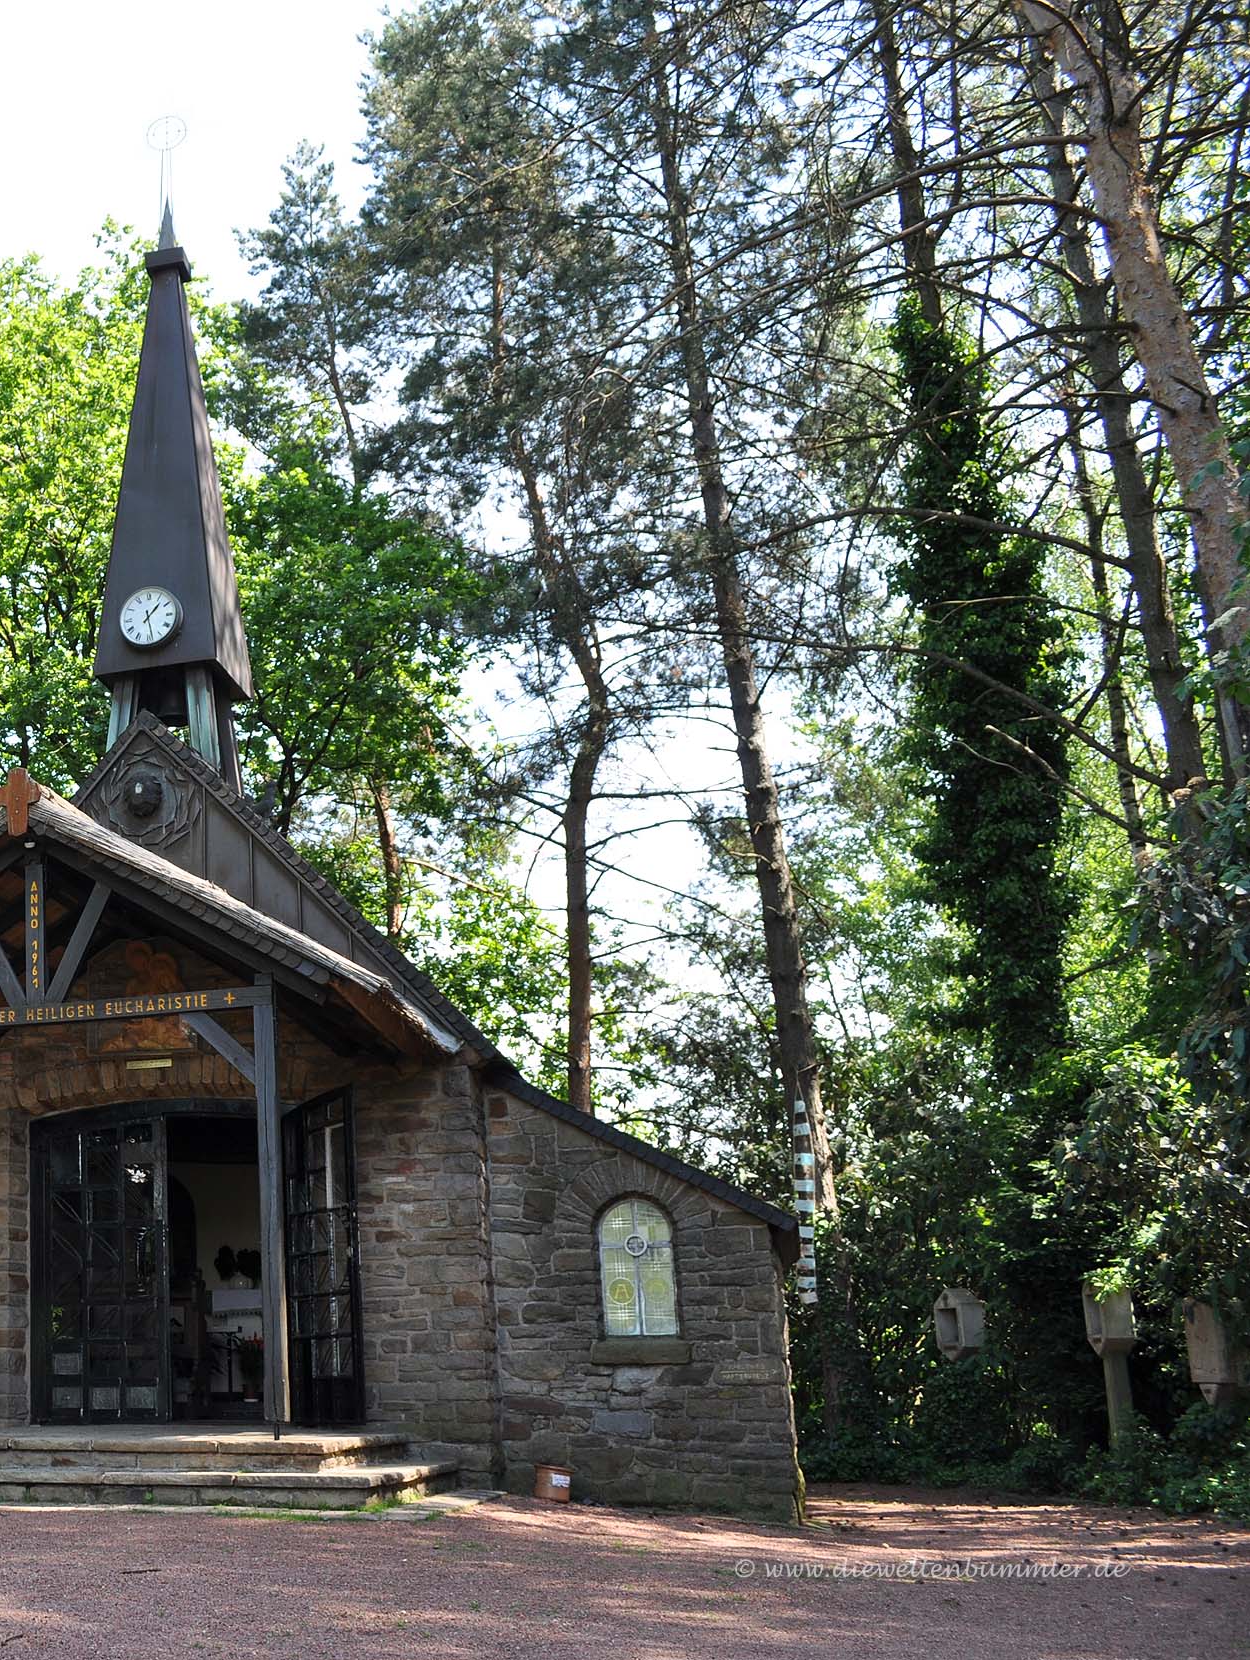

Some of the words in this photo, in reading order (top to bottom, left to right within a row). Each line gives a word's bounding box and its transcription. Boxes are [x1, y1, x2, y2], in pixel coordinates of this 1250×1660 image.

[30, 880, 39, 929] ANNO
[31, 940, 39, 989] 1961
[26, 1004, 95, 1021] HEILIGEN
[105, 994, 207, 1015] EUCHARISTIE
